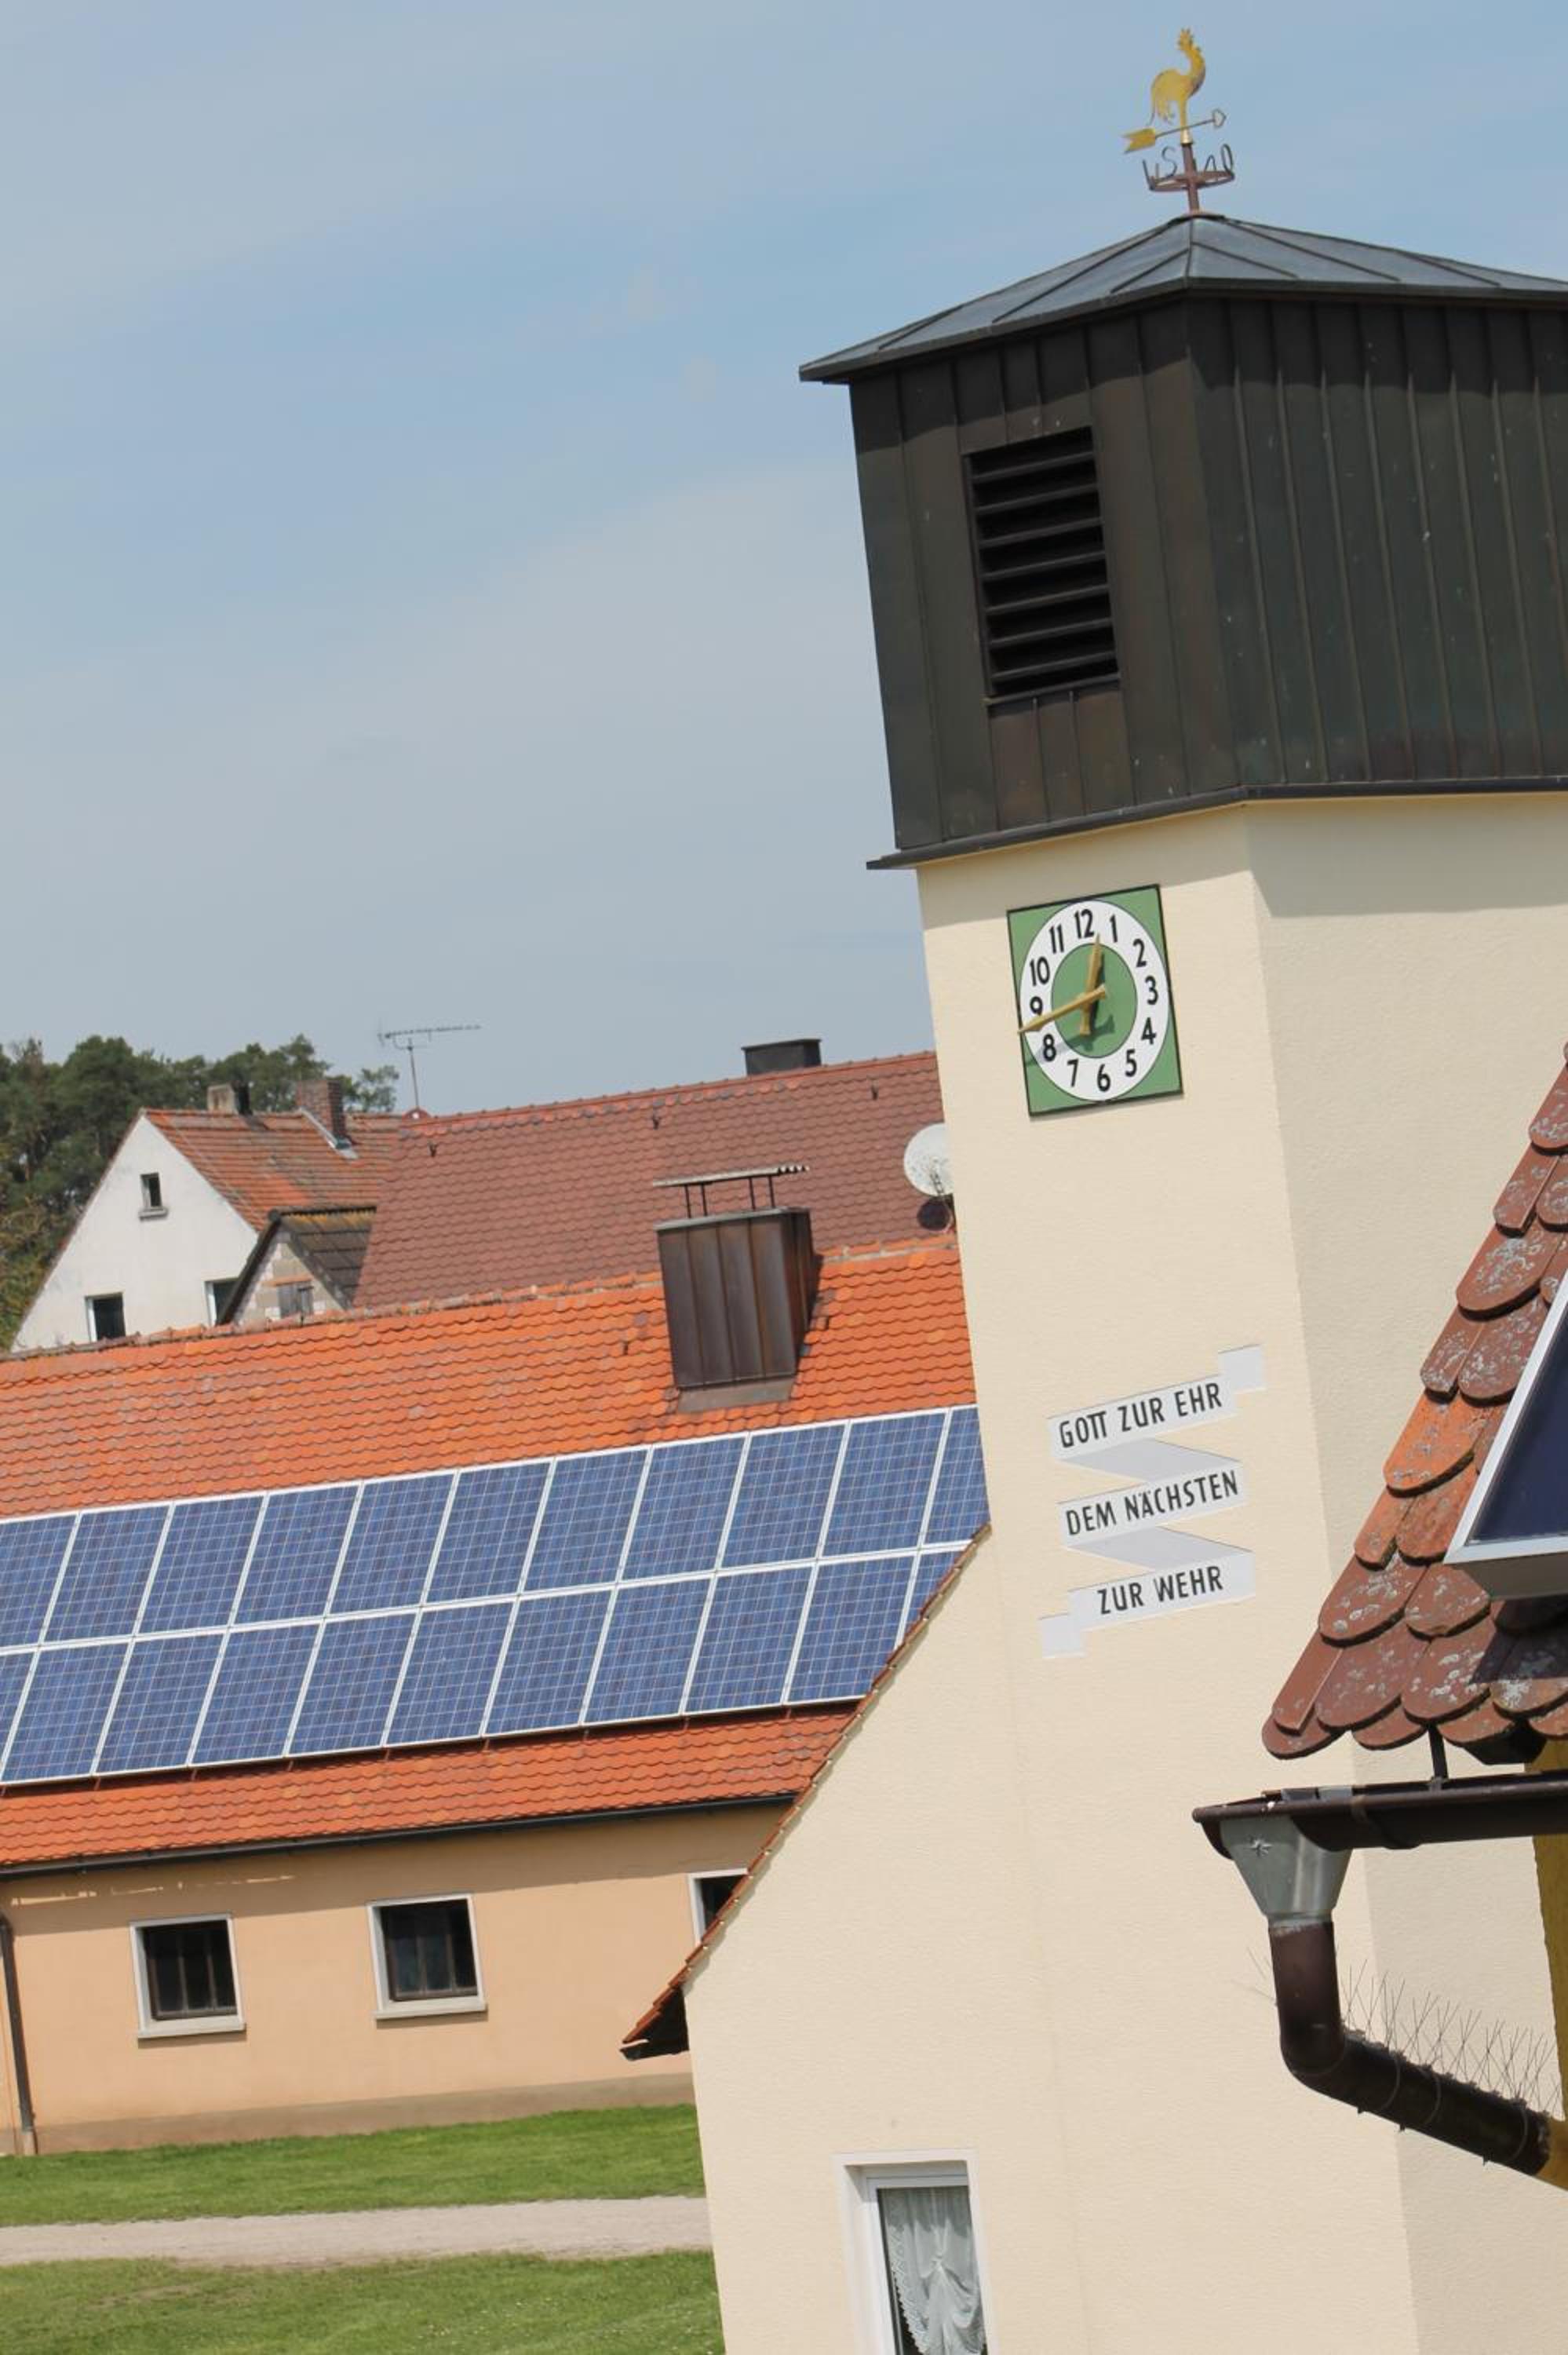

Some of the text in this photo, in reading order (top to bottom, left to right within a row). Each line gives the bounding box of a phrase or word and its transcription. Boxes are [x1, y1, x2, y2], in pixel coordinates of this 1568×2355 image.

[1048, 923, 1064, 954] 11
[1074, 908, 1095, 939] 12
[1110, 914, 1118, 943] 1
[1132, 938, 1147, 968] 2
[1029, 956, 1051, 987] 10
[1144, 975, 1159, 1006] 3
[1029, 995, 1044, 1017] 9
[1140, 1017, 1157, 1045] 4
[1042, 1033, 1057, 1062] 8
[1067, 1058, 1079, 1087] 7
[1096, 1064, 1111, 1093] 6
[1125, 1049, 1138, 1078] 5
[1059, 1382, 1223, 1448] GOTT ZUR EHR
[1065, 1470, 1238, 1535] DEM NÄCHSTEN
[1096, 1565, 1223, 1615] ZUR WEHR
